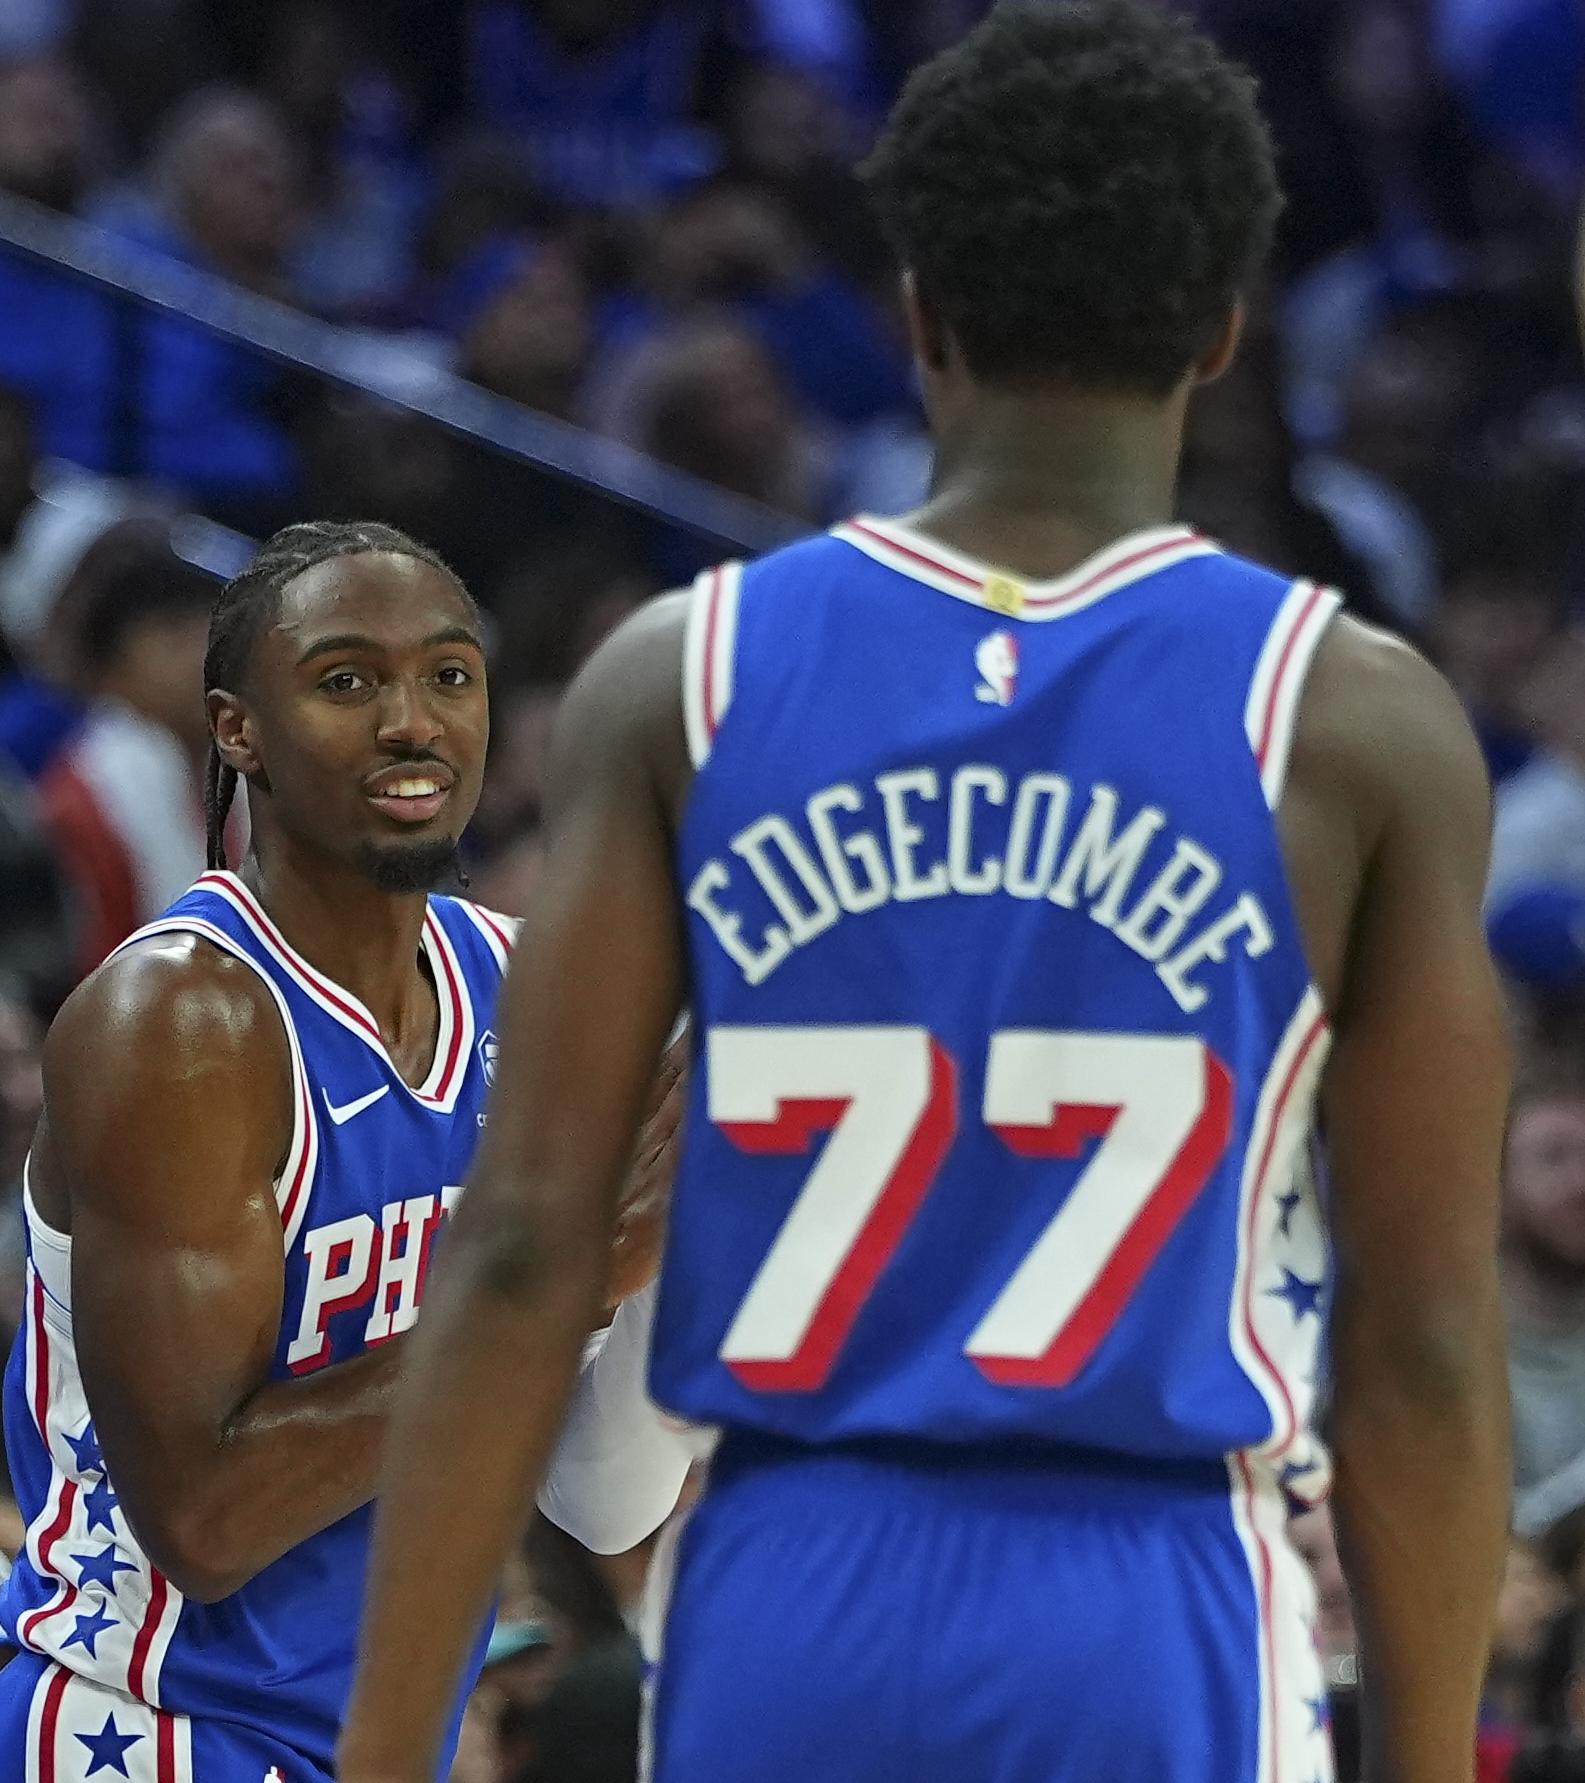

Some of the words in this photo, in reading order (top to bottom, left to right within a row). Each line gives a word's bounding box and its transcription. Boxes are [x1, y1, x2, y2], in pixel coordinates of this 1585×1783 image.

[688, 764, 1275, 1014] EDGECOMBE
[287, 1186, 465, 1376] PH
[706, 1026, 1234, 1391] 77
